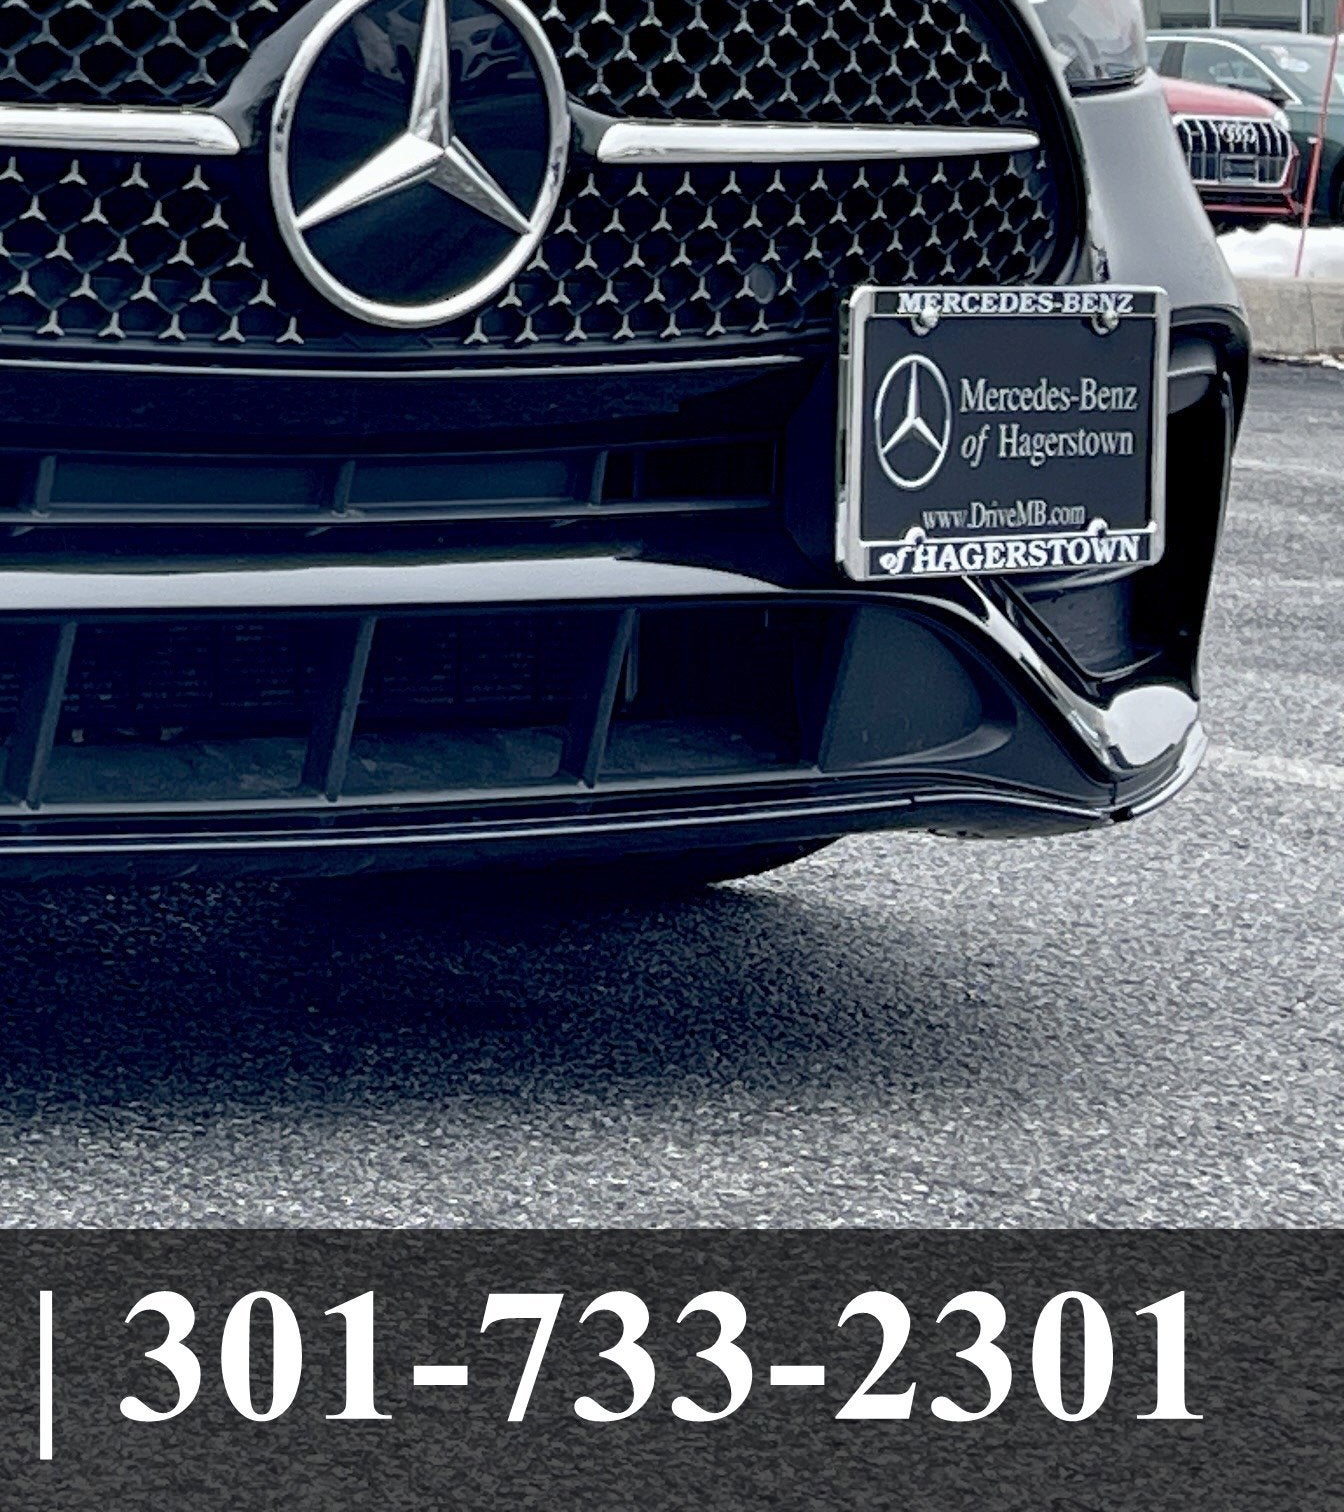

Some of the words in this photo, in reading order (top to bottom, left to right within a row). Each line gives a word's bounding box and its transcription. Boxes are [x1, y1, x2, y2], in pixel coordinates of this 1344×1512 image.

[897, 292, 1134, 315] MERCEDES-BENZ
[960, 377, 1138, 413] Mercedes-Benz
[961, 423, 990, 467] of
[998, 423, 1134, 466] Hagerstown
[922, 499, 1086, 530] www.DriveMB.com
[879, 545, 914, 574] of
[912, 536, 1141, 573] HAGERSTOWN
